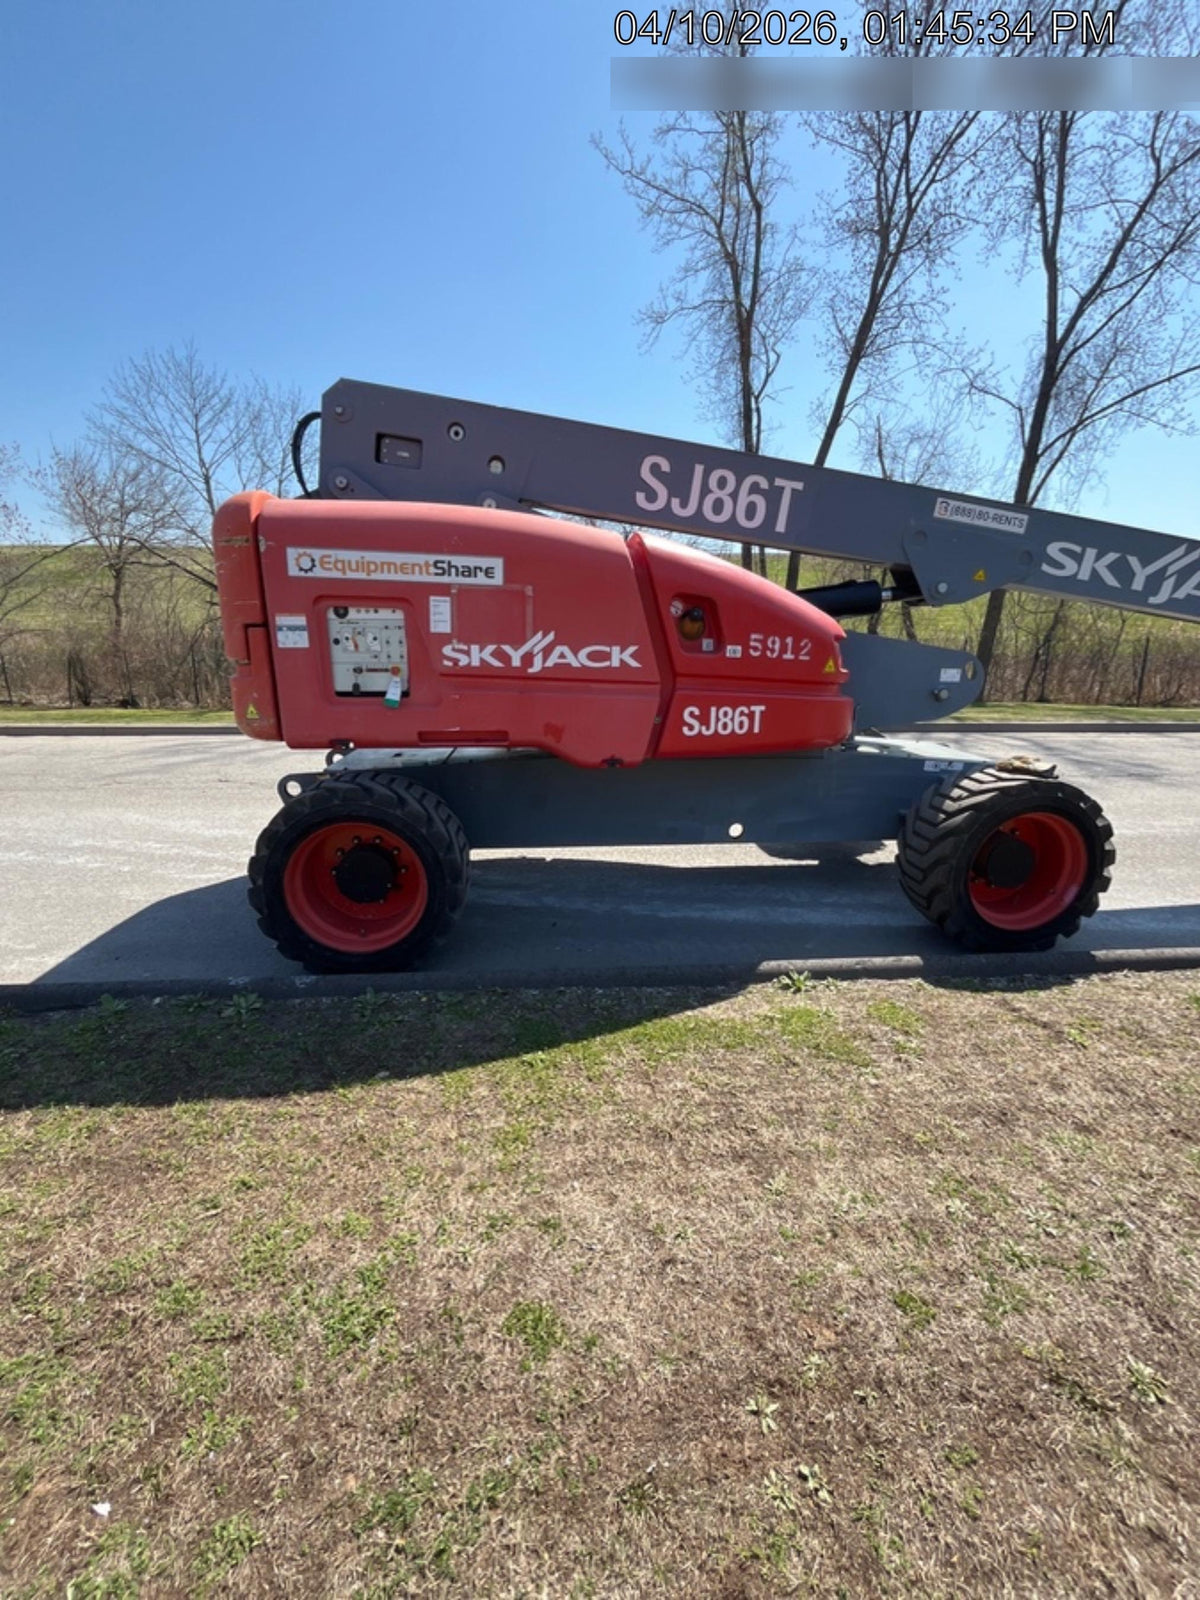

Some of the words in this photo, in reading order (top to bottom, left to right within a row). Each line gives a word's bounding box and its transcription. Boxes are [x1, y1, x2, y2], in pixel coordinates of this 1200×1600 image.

[635, 454, 805, 533] SJ86T
[318, 553, 496, 580] EquipmentShare
[441, 630, 643, 673] SKYJACK
[749, 633, 812, 660] 5912
[681, 705, 766, 736] SJ86T
